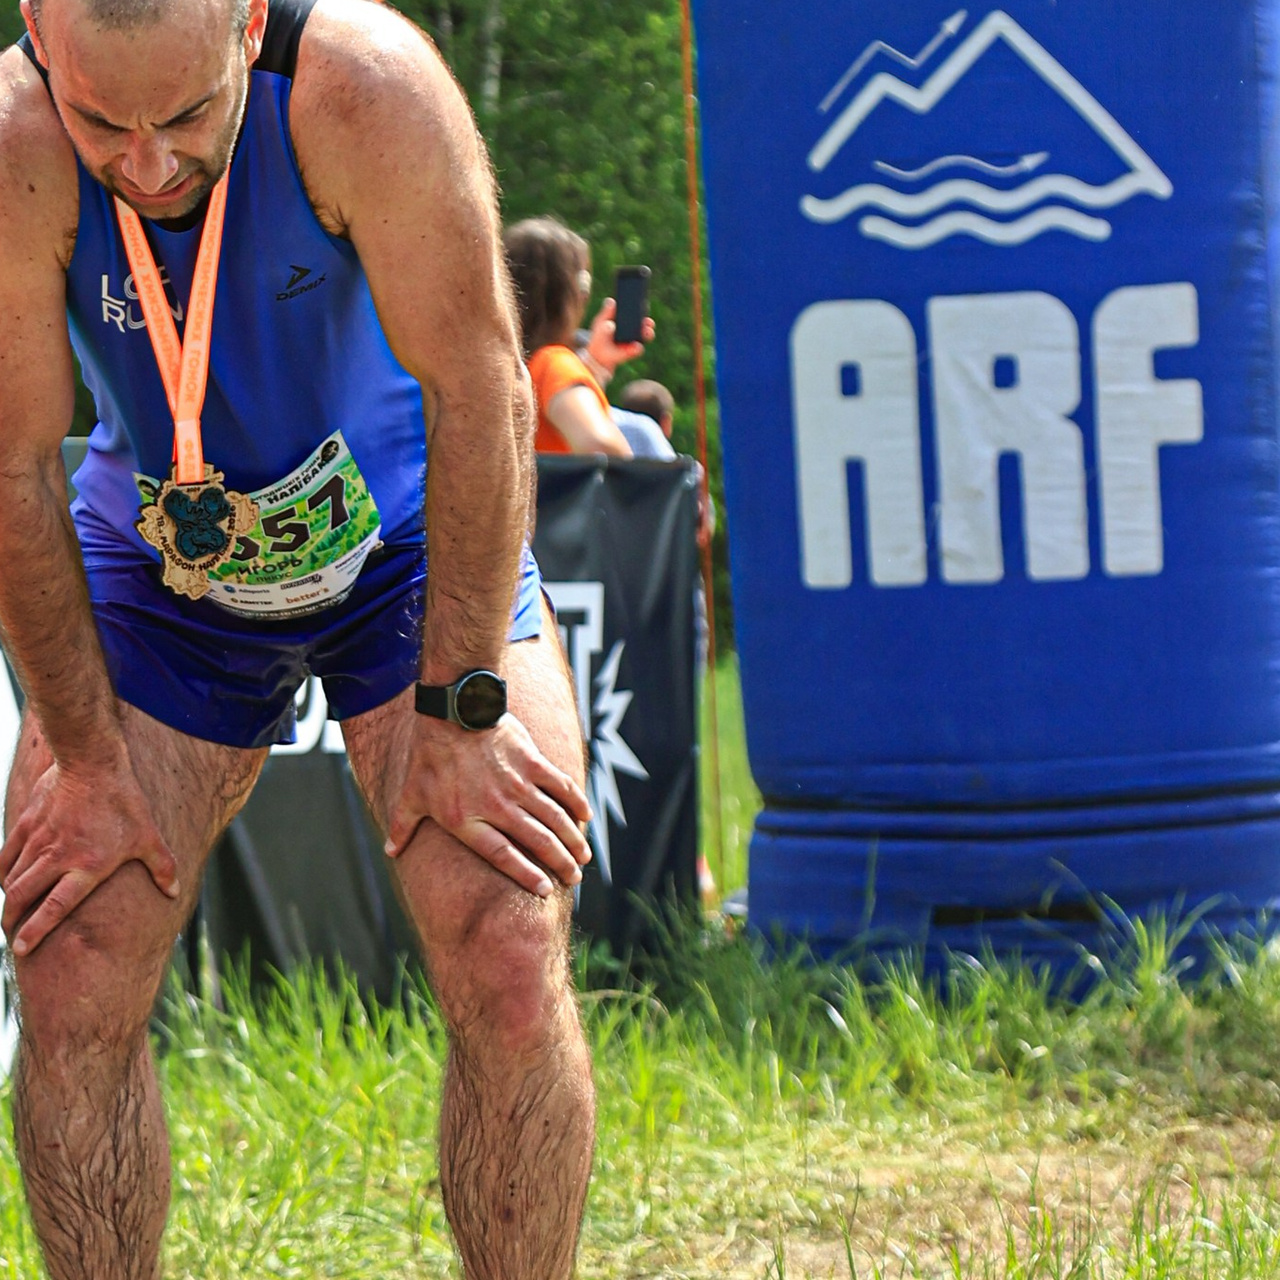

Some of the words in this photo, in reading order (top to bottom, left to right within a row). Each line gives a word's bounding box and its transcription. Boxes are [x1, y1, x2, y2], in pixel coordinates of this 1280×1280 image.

[275, 273, 326, 300] DEMIX
[789, 281, 1204, 589] ARF
[160, 535, 196, 572] МАРАФОН
[237, 558, 304, 576] ИГОРЬ
[285, 587, 330, 604] better's
